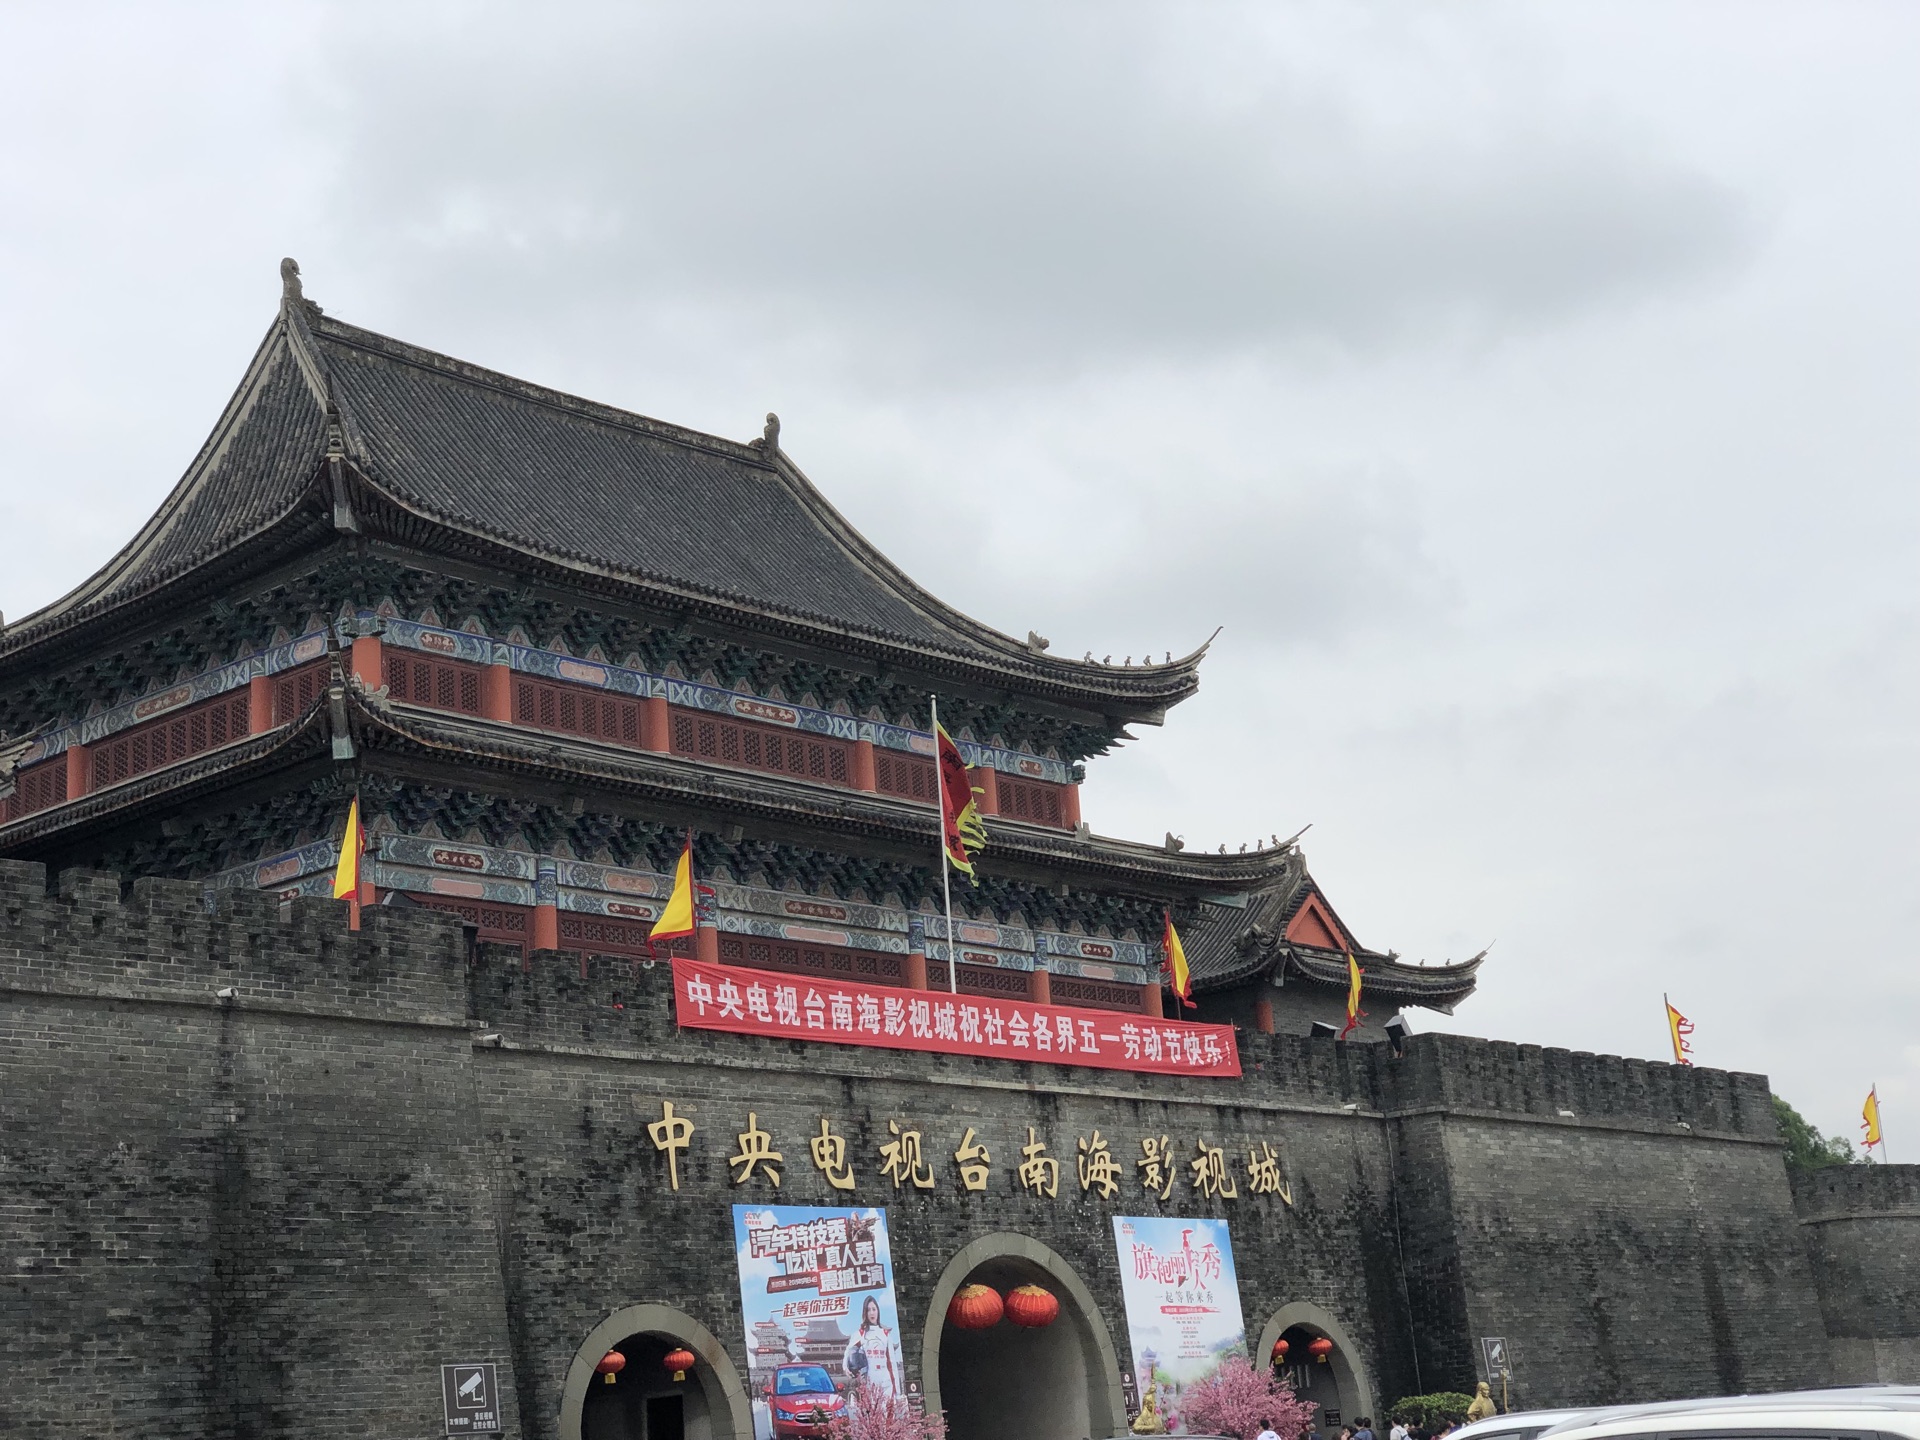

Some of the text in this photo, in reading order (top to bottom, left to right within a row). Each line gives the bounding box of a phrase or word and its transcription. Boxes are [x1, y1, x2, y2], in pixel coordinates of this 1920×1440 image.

[647, 1100, 1292, 1206] 中央电视台南海影视城
[750, 1218, 848, 1255] 汽车特技秀
[820, 1266, 886, 1292] 震撼上演
[1155, 1290, 1214, 1304] 一起等你来秀
